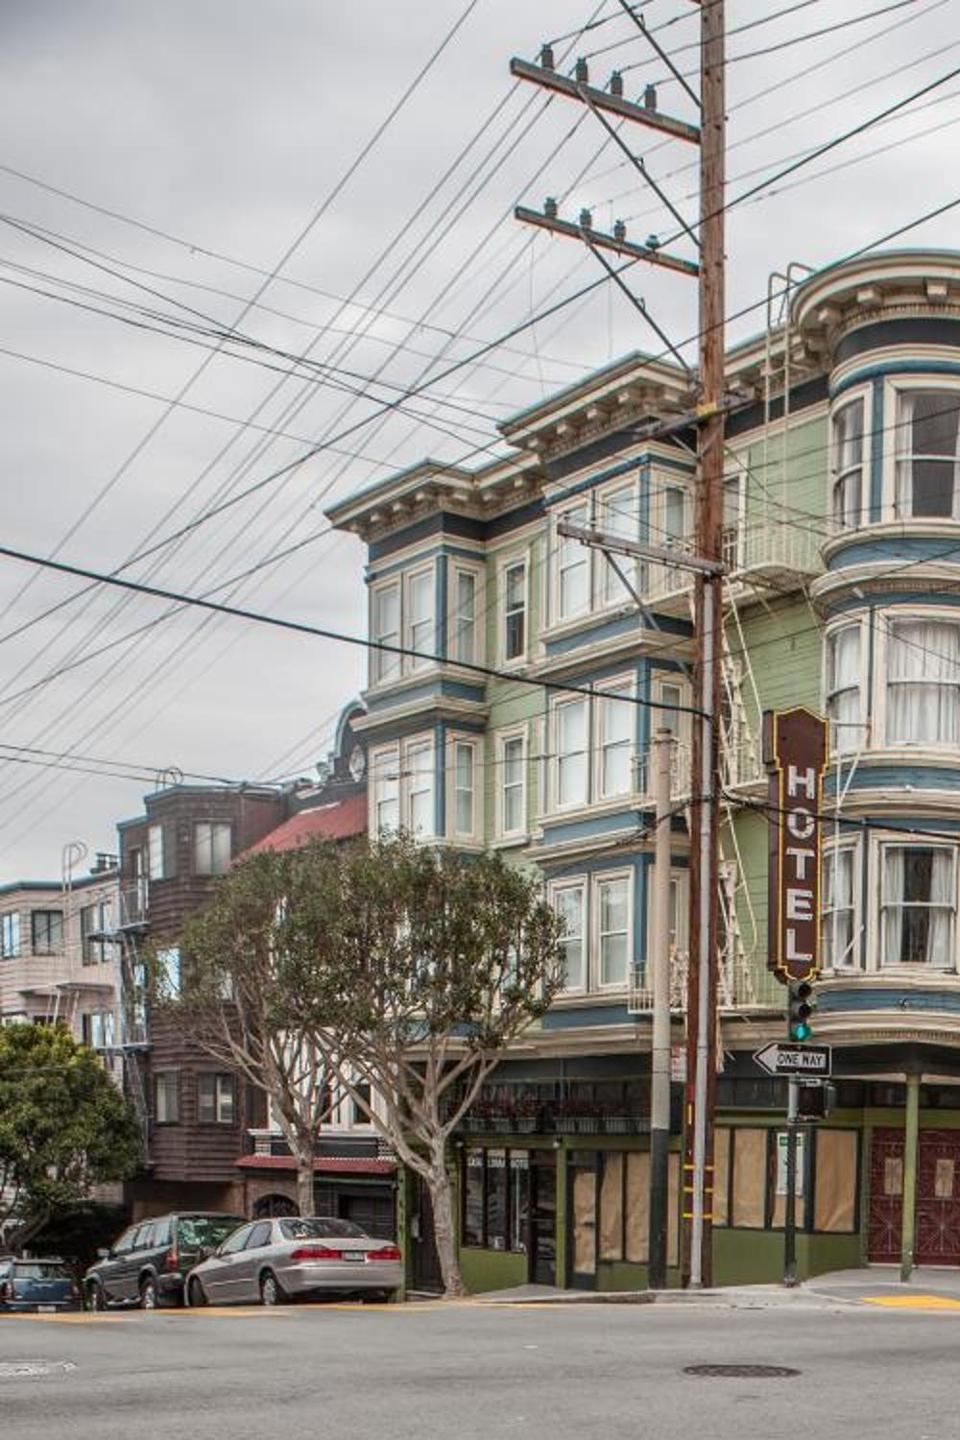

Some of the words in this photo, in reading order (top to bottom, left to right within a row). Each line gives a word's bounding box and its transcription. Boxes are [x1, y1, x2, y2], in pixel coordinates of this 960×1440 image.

[786, 765, 815, 962] HOTEL
[777, 1052, 799, 1065] ONE
[802, 1053, 823, 1066] WAY
